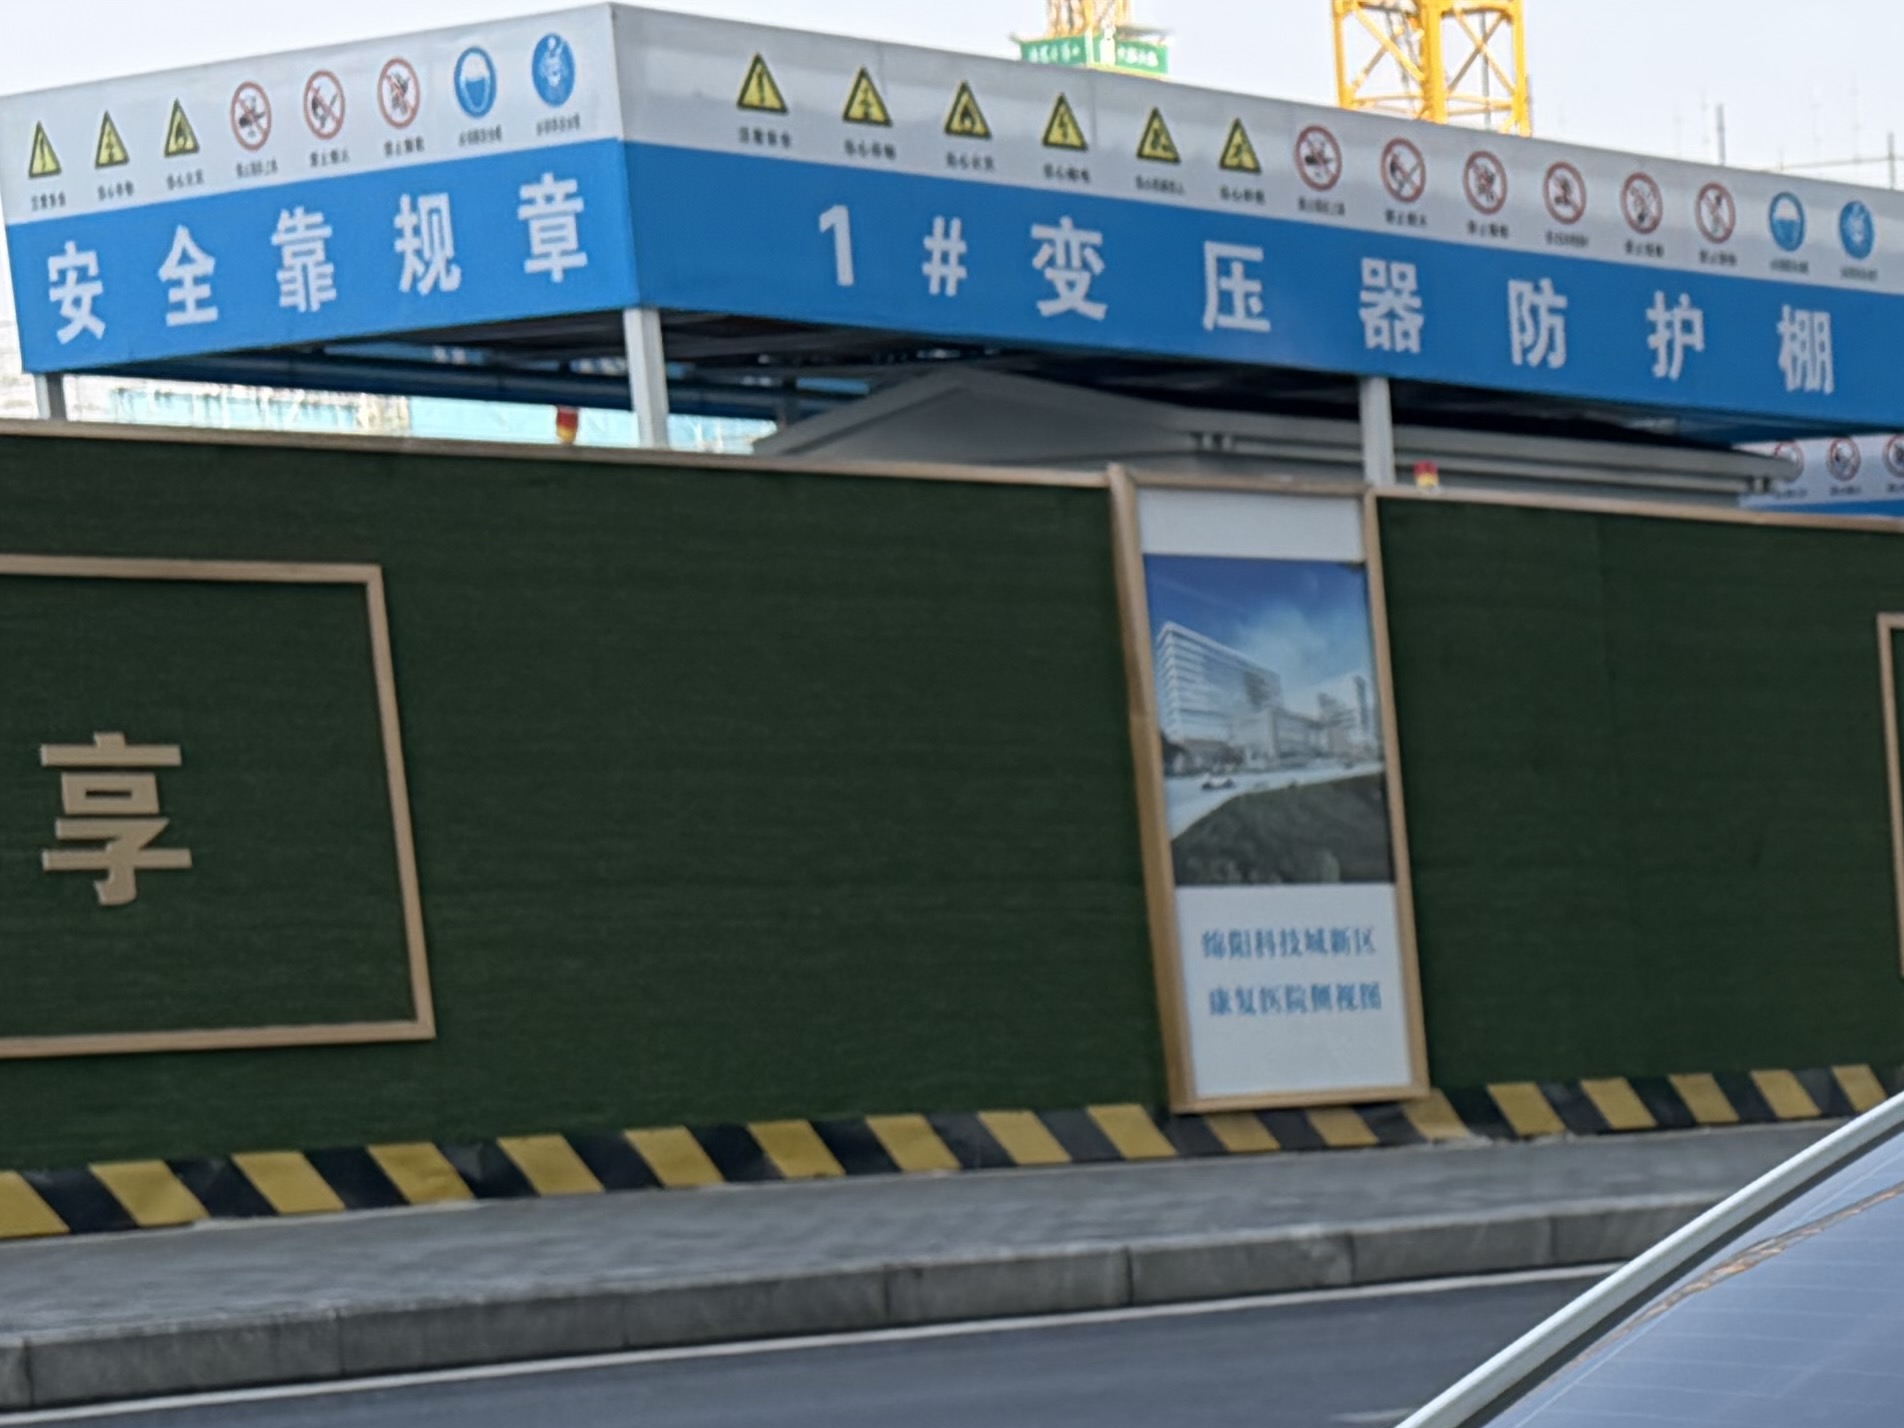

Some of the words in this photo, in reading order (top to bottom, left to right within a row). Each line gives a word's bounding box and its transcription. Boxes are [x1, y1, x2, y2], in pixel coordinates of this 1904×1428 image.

[48, 172, 588, 345] 安全靠规章
[40, 731, 192, 905] 享
